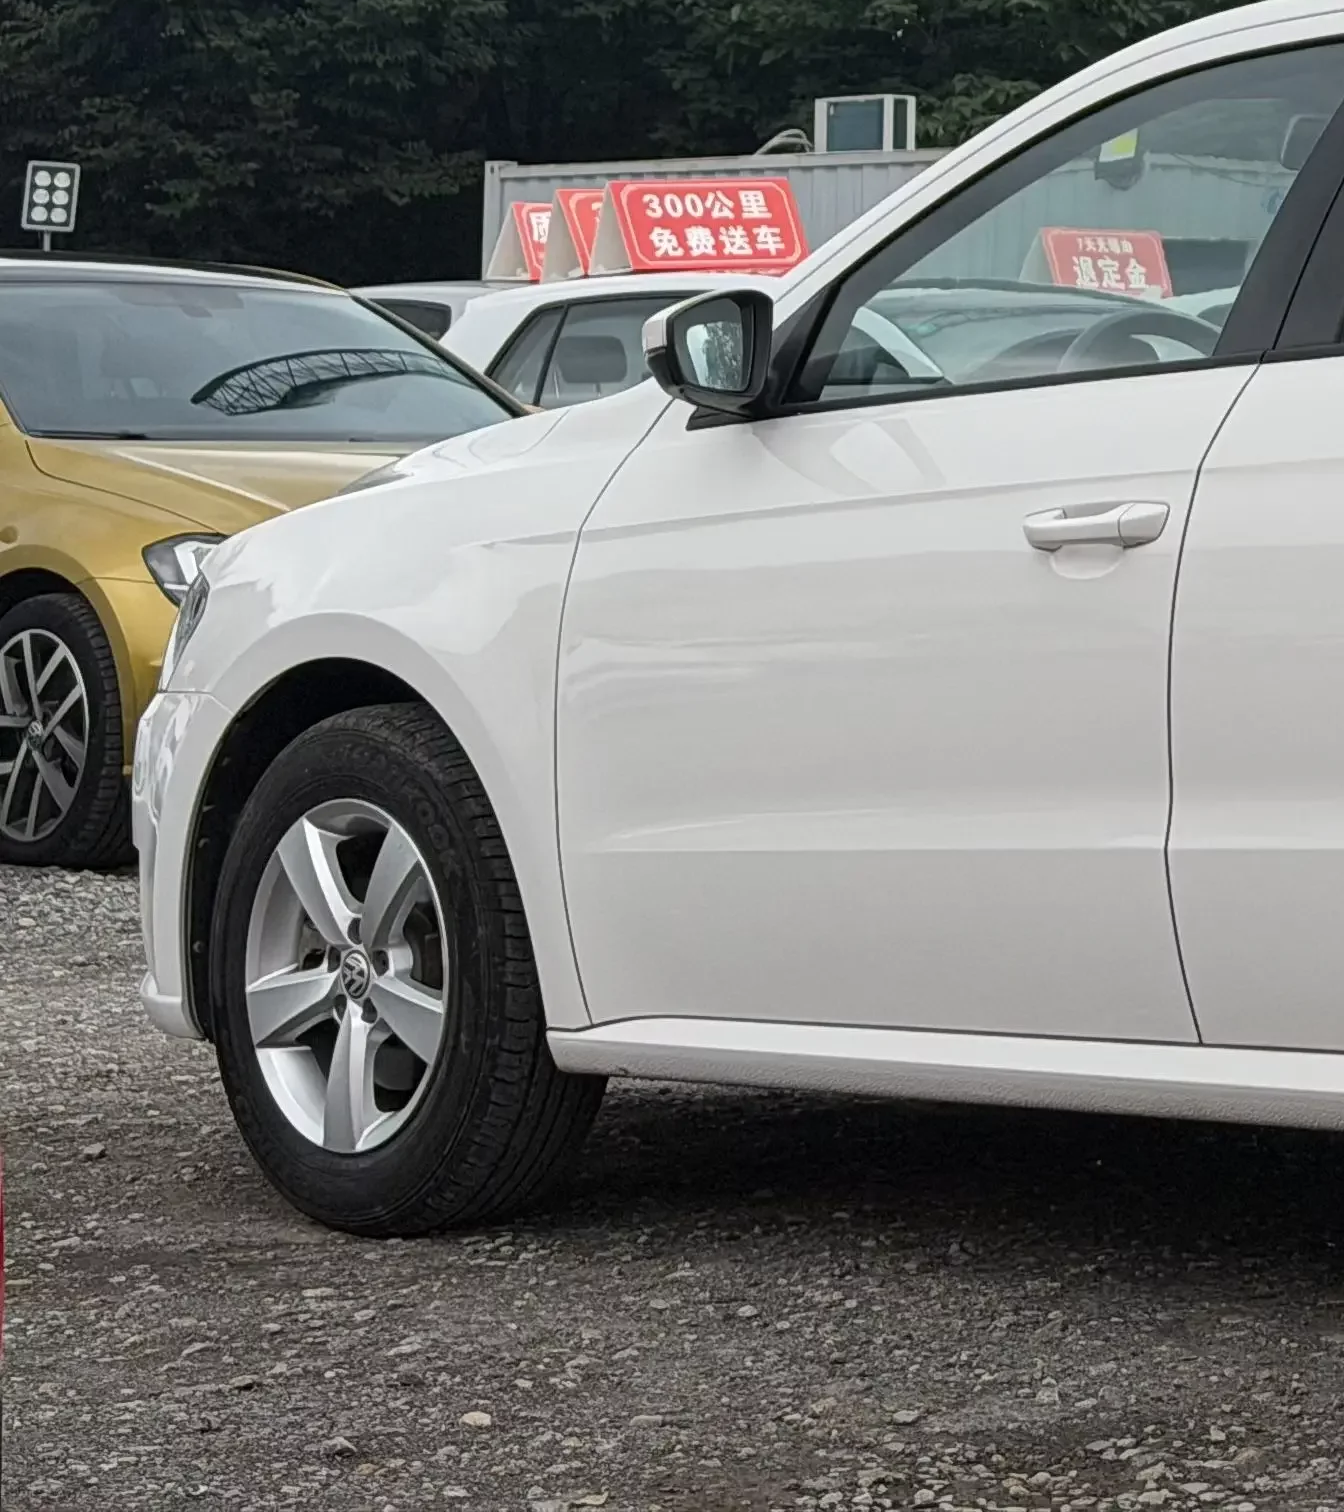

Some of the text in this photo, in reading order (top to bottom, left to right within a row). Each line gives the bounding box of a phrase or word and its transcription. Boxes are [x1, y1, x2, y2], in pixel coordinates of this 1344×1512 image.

[641, 190, 773, 220] 300公里
[648, 224, 786, 258] 免费送车
